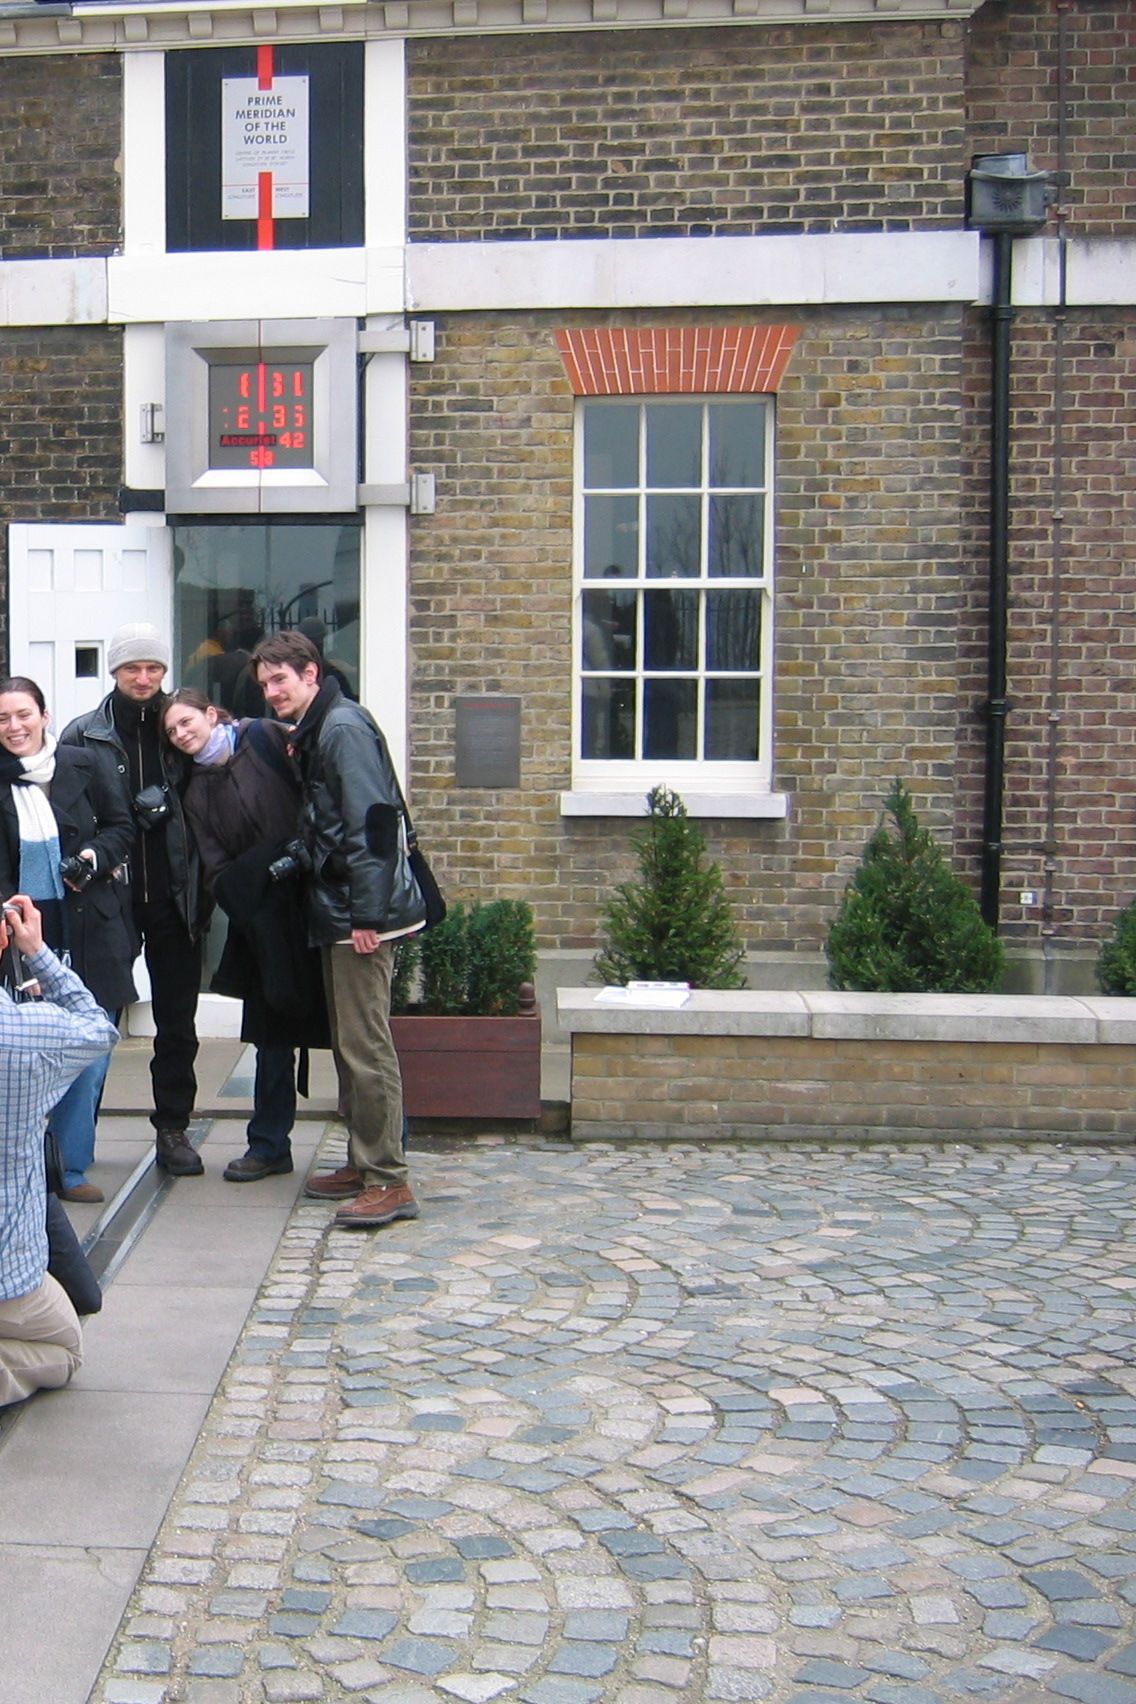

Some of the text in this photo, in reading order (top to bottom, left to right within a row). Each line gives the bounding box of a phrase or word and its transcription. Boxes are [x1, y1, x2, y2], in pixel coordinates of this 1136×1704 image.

[247, 96, 283, 106] PRIME
[235, 108, 296, 119] MERIDIAN
[244, 121, 287, 132] OF THE
[243, 134, 288, 145] WORLD
[279, 432, 304, 449] 42
